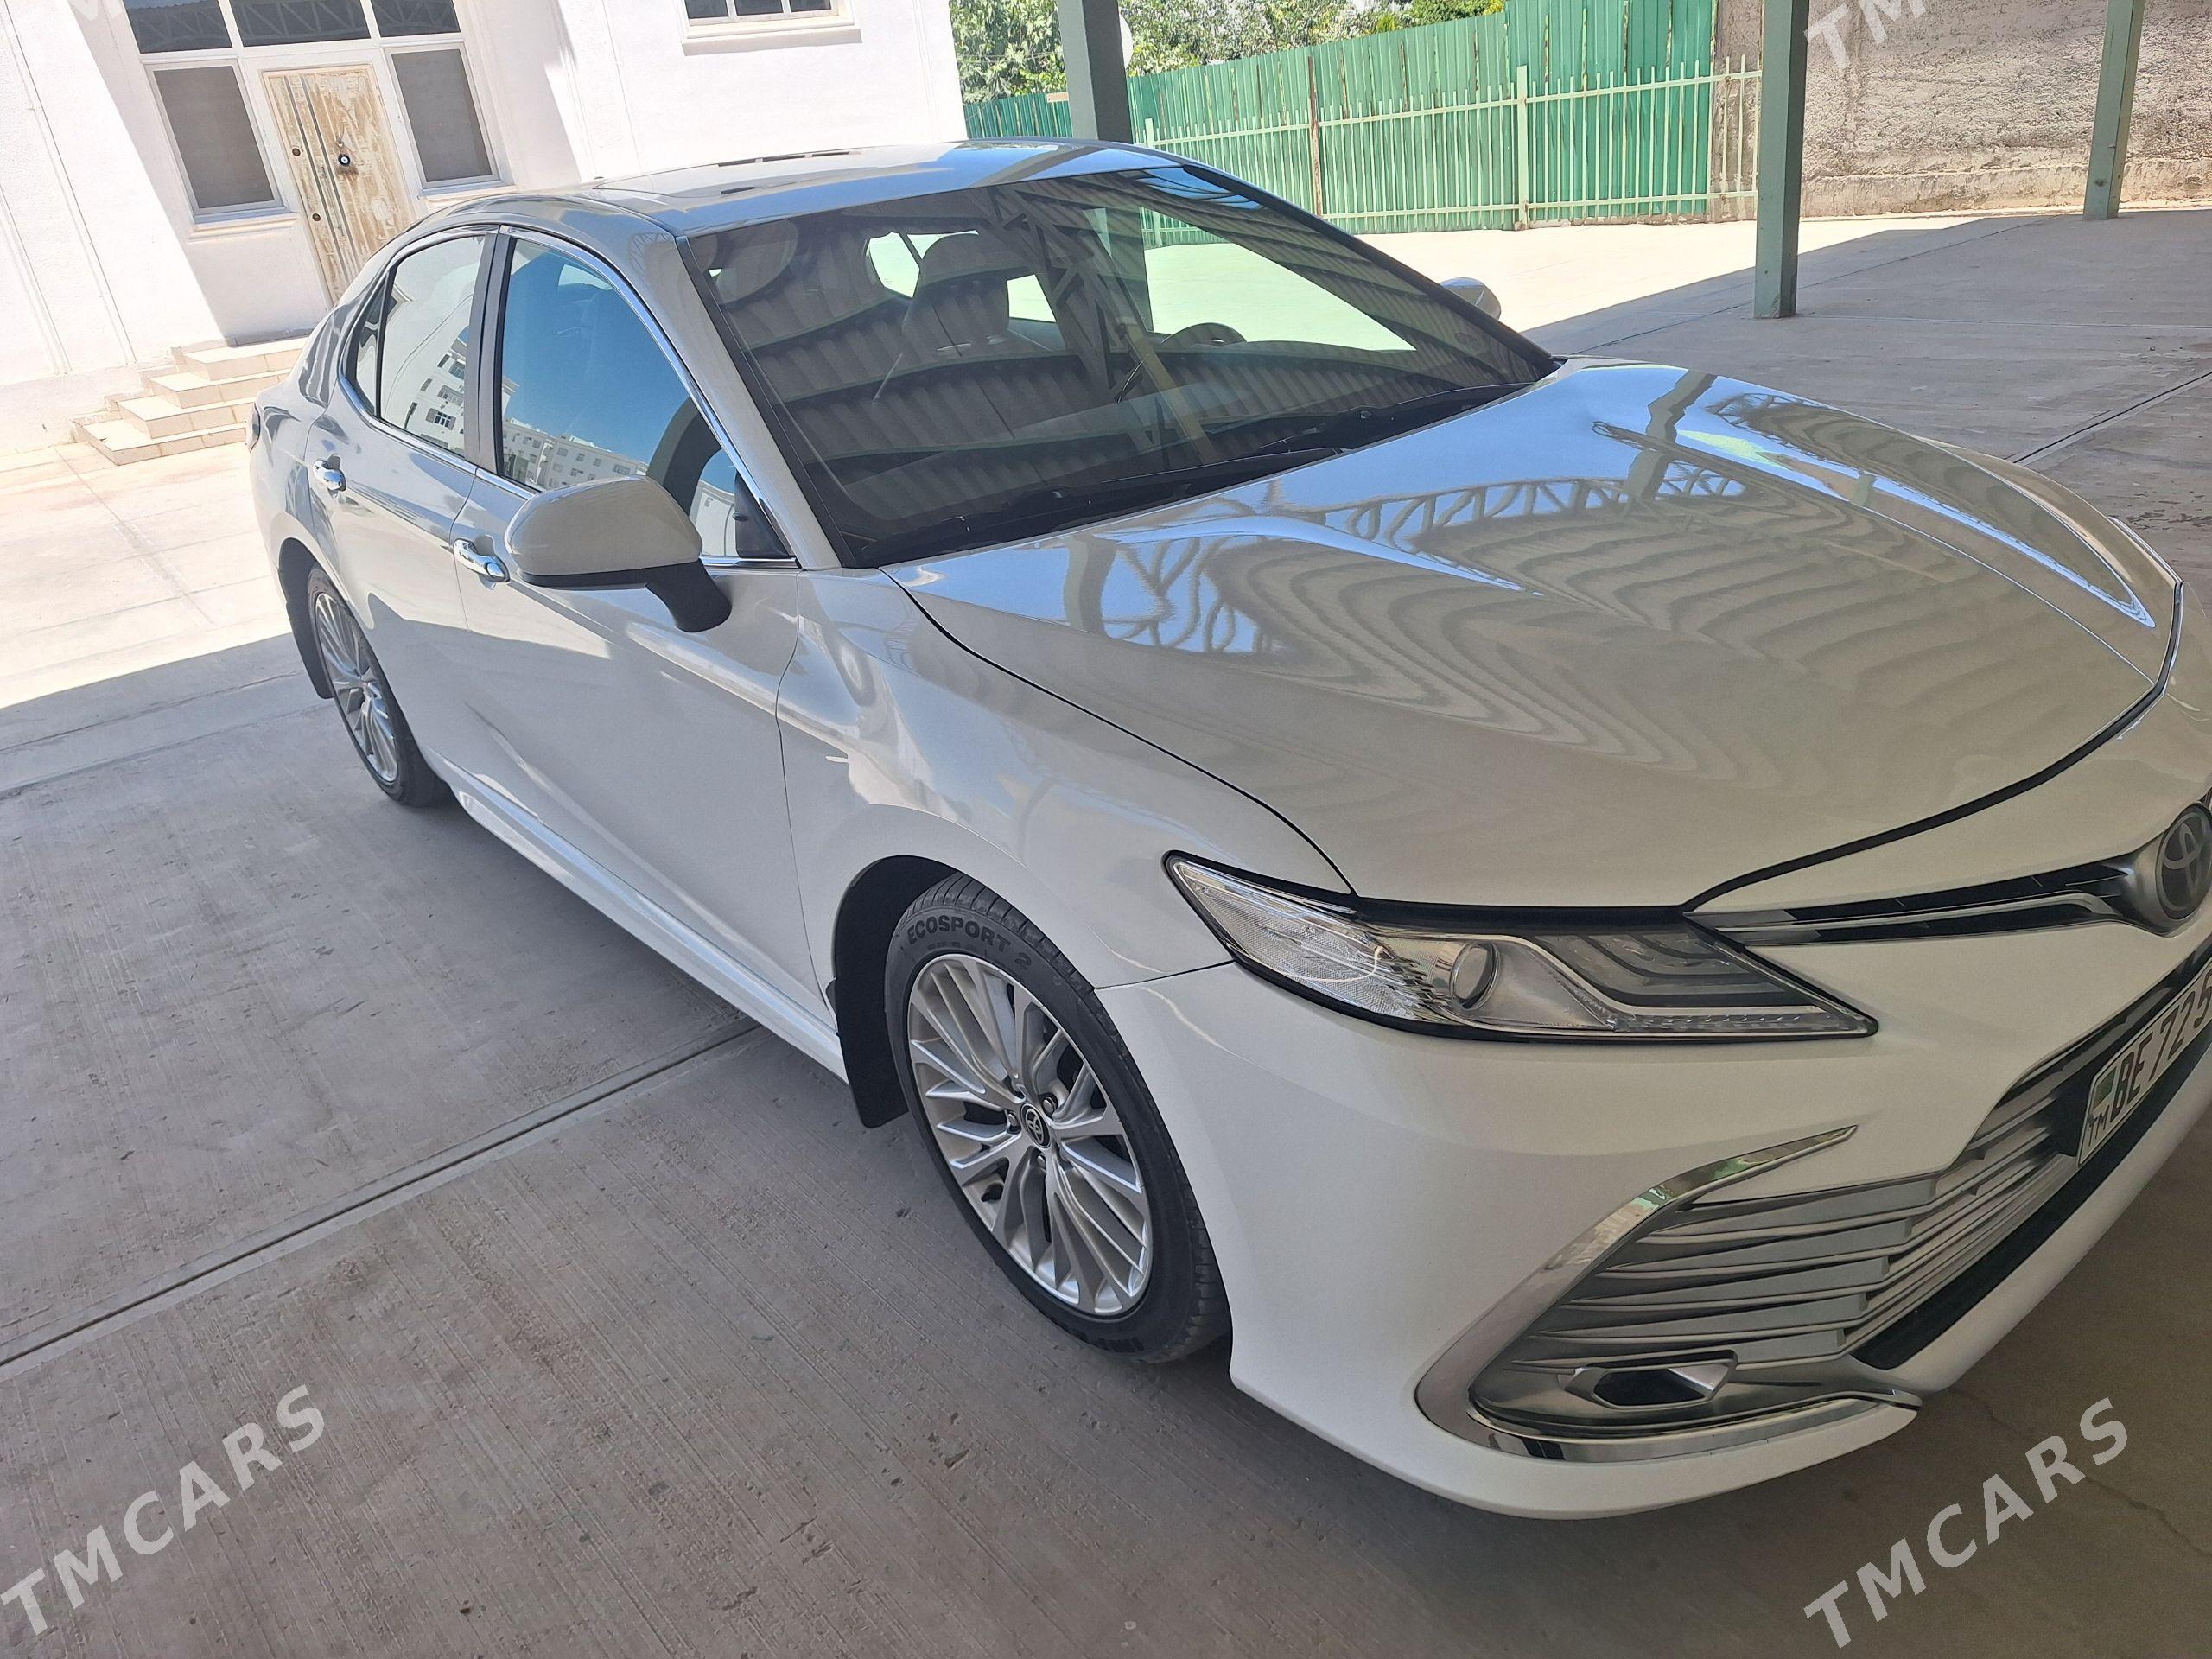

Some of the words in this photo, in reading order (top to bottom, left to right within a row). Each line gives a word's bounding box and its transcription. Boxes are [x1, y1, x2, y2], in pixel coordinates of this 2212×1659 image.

[907, 915, 1012, 952] ECOSPORT
[1014, 952, 1033, 971] 2
[2109, 1032, 2154, 1123] BE
[2087, 1104, 2111, 1147] TM
